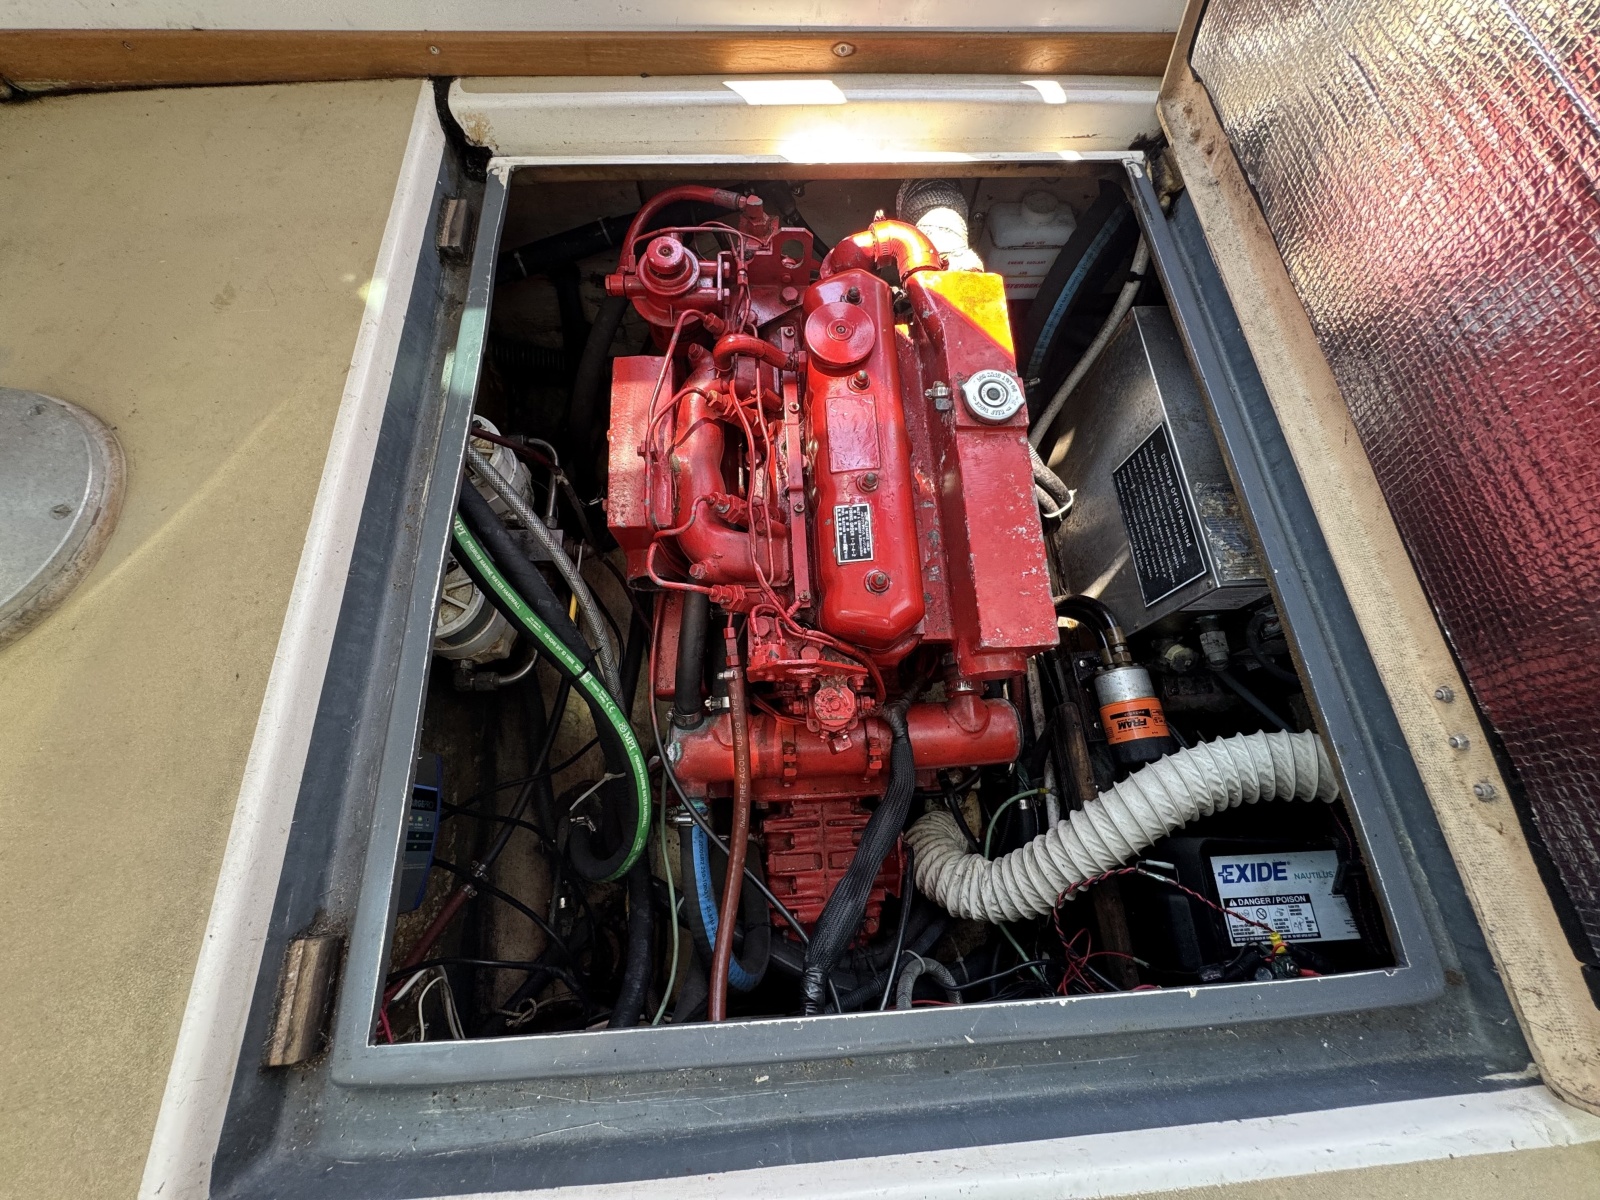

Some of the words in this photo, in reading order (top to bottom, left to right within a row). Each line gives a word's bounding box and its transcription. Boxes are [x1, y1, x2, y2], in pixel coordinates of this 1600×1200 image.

[1161, 453, 1173, 486] Discharge
[1170, 487, 1177, 496] Of
[1177, 509, 1191, 547] Prohibited
[466, 540, 481, 560] PREMIUM
[479, 560, 493, 575] MARINE
[491, 575, 504, 589] WATER
[502, 588, 520, 609] HARDWALL
[731, 693, 739, 716] TYPE
[734, 722, 742, 750] "USCG
[1117, 718, 1147, 731] FRAM
[623, 731, 636, 750] MPI
[634, 755, 643, 773] PREMIUM
[639, 805, 648, 827] HARDWALL
[738, 754, 746, 802] FIRE-ACOL
[1218, 862, 1288, 884] EXIDE
[1294, 871, 1334, 880] NAUTILUS
[1238, 897, 1271, 906] DANGER
[1276, 895, 1306, 903] POISON
